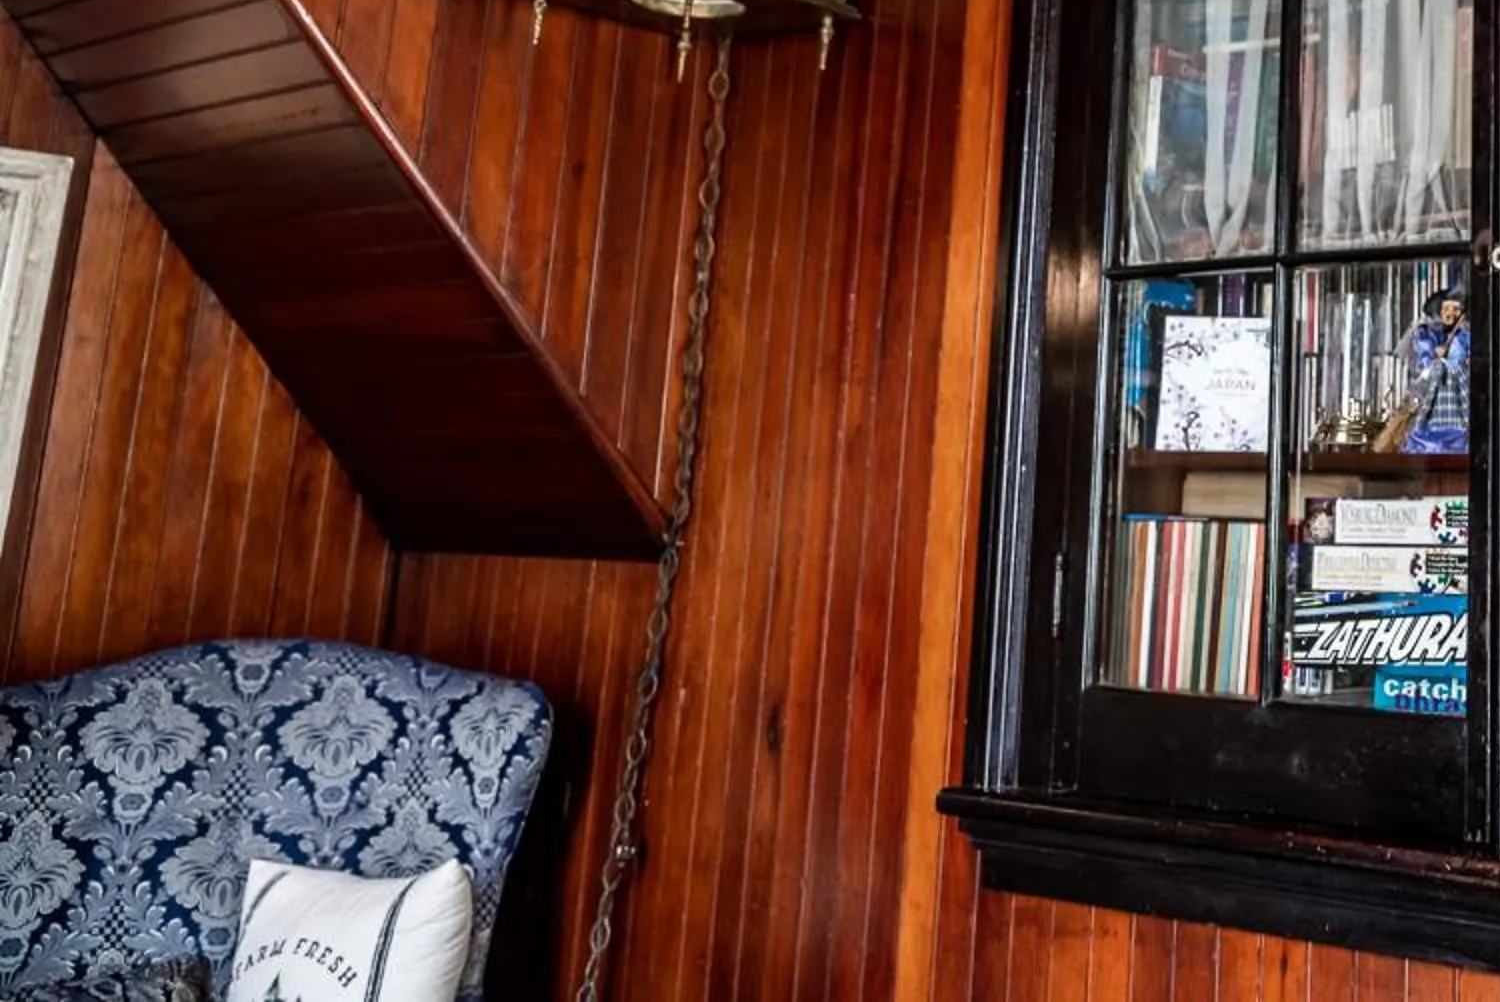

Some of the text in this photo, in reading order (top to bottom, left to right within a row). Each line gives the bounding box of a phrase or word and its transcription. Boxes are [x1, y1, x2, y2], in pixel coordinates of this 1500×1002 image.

[1205, 377, 1256, 391] JAPAN
[1294, 612, 1468, 666] ZATHURA
[1383, 678, 1467, 703] catch
[234, 937, 359, 989] FARM FRESH
